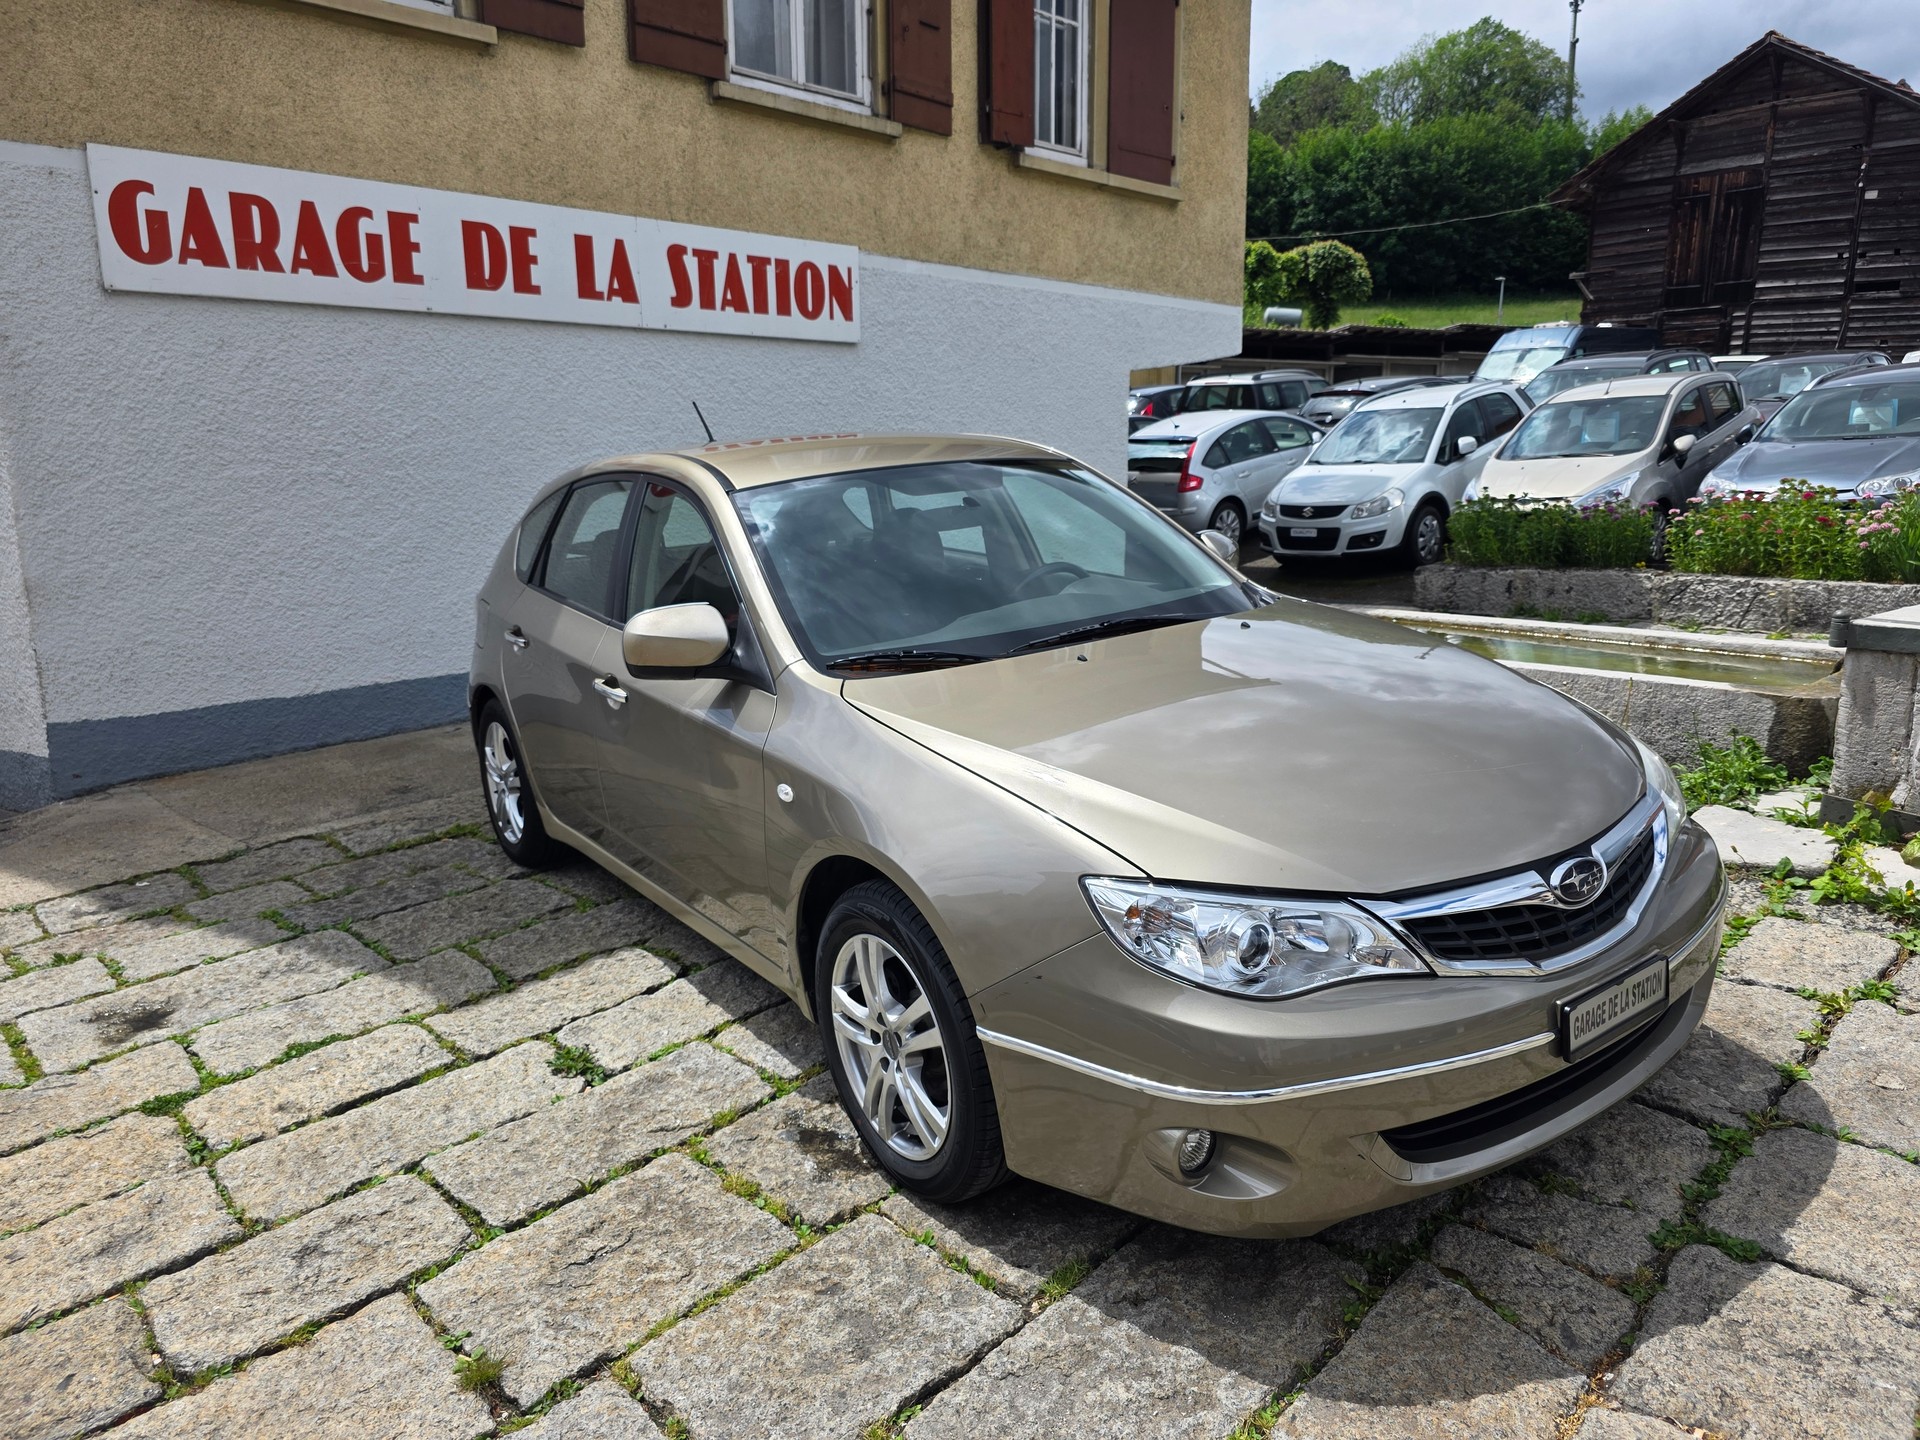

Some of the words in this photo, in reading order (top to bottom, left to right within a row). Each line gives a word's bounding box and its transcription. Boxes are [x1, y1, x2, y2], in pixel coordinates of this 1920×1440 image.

[109, 180, 424, 284] GARAGE
[462, 221, 540, 294] DE
[575, 235, 640, 303] LA
[667, 244, 852, 321] STATION
[1573, 1001, 1606, 1040] GARAGE
[1608, 994, 1618, 1021] DE
[1620, 988, 1630, 1013] LA
[1632, 970, 1662, 1007] STATION
